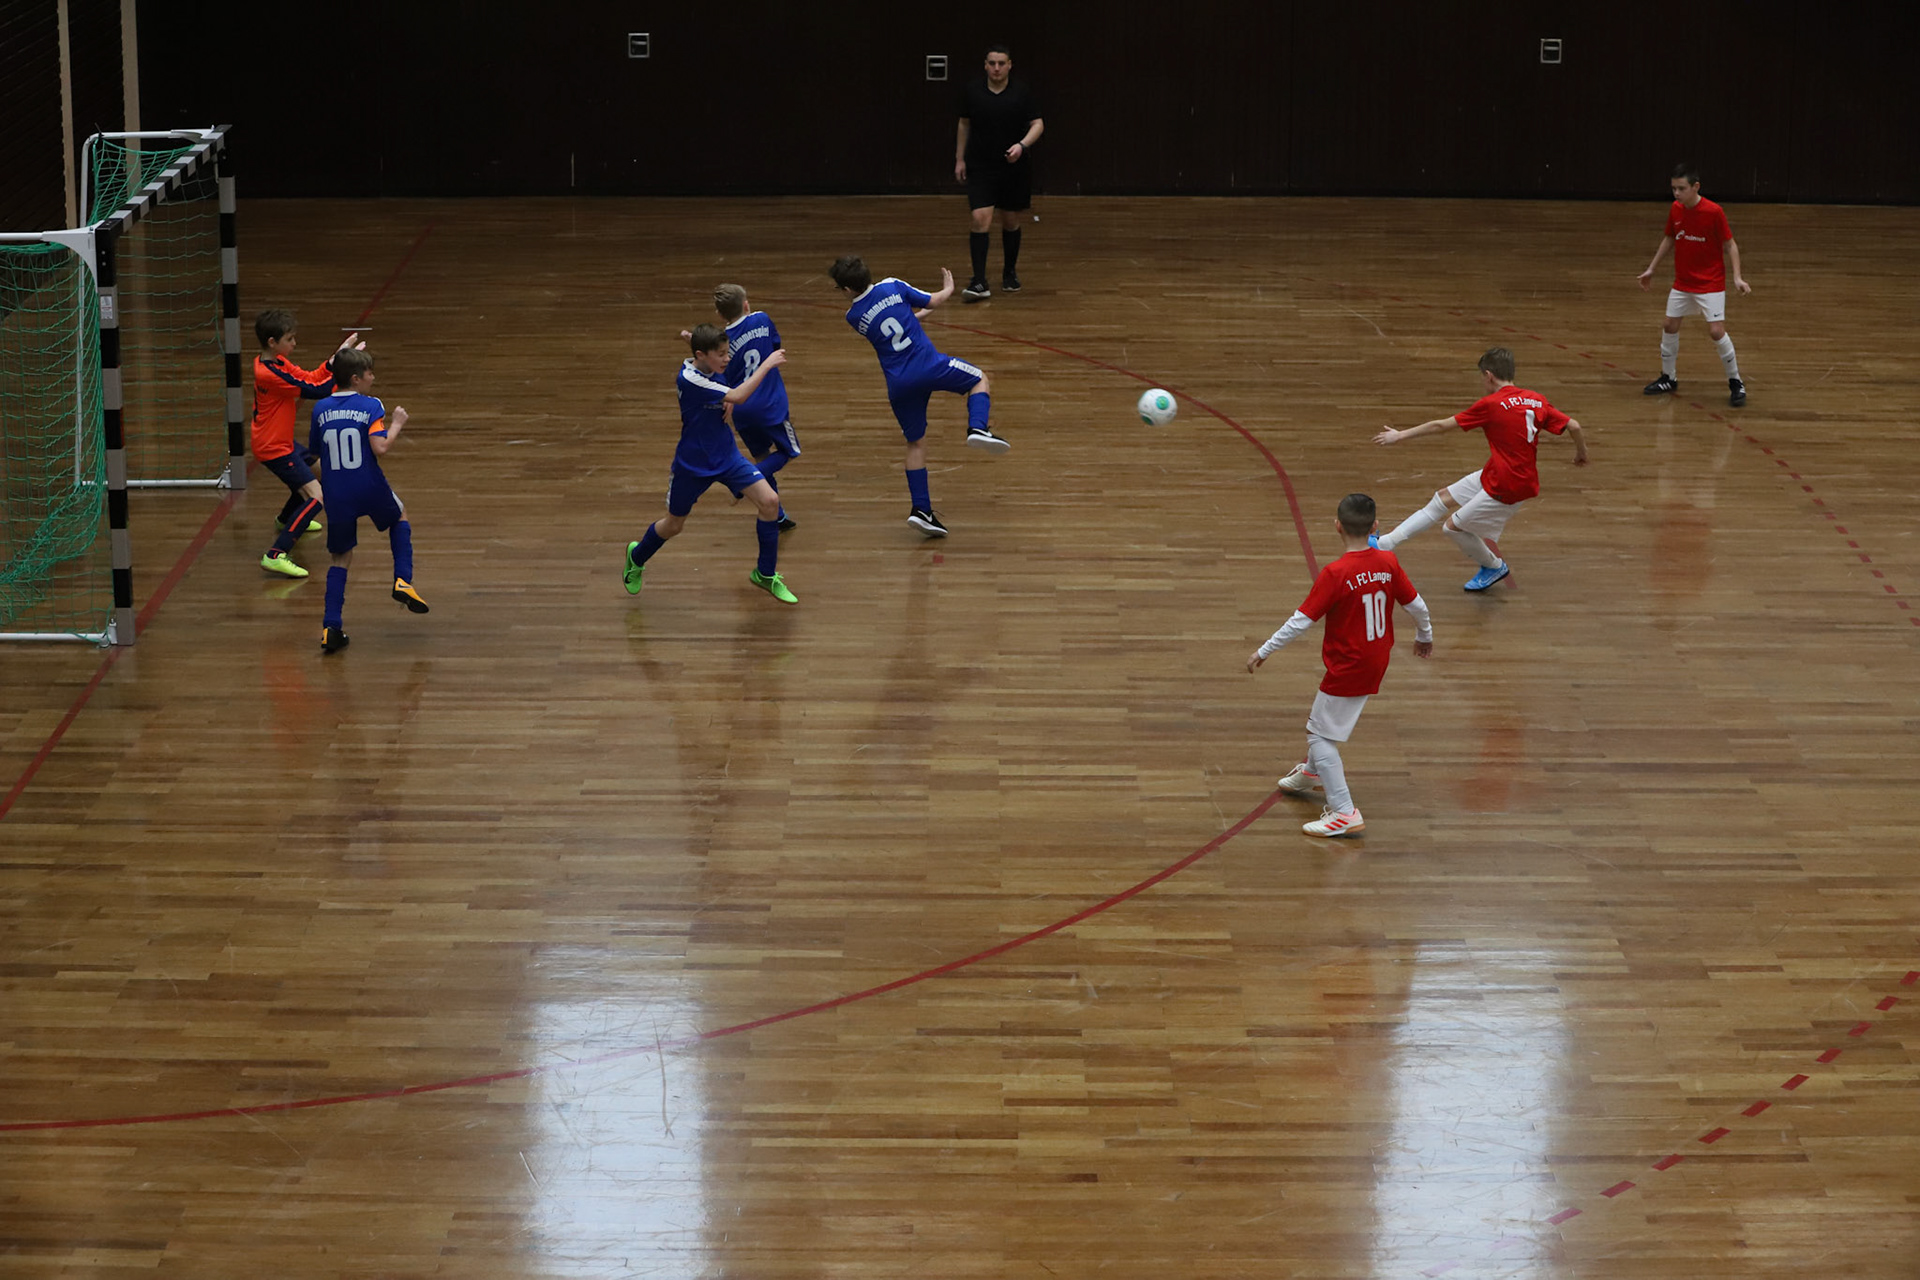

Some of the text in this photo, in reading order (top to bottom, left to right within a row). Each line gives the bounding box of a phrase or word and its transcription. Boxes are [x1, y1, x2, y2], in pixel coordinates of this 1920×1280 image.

[861, 293, 903, 324] Lämmerspiel
[880, 317, 912, 352] 2
[1500, 400, 1511, 410] 1.
[1508, 397, 1519, 407] FC
[322, 427, 362, 470] 10
[1346, 579, 1357, 591] 1.
[1356, 572, 1368, 586] FC
[1362, 590, 1387, 642] 10
